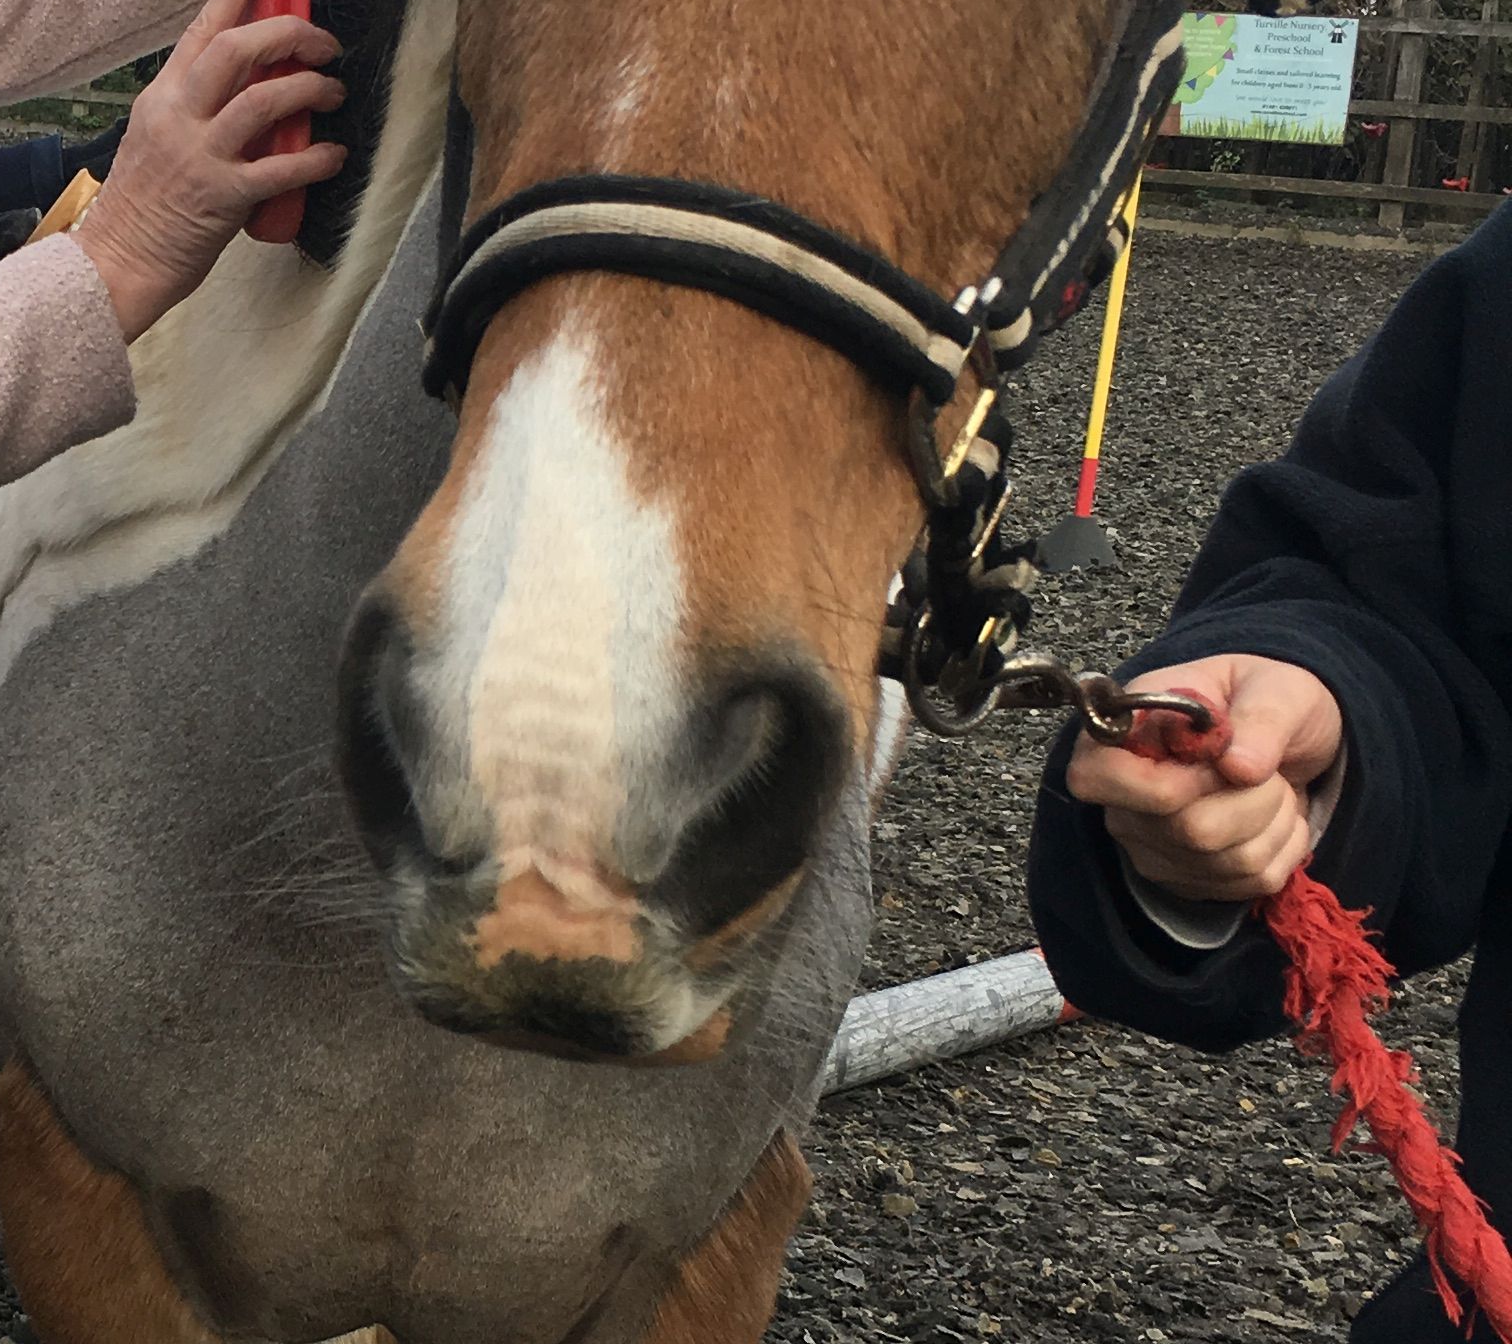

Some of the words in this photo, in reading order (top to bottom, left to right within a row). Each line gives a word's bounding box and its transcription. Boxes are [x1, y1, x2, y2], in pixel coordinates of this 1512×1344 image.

[1255, 19, 1288, 29] Turville
[1267, 32, 1311, 42] Preschool
[1254, 45, 1261, 53] &
[1263, 45, 1291, 54] Forest
[1293, 45, 1324, 56] School
[1289, 70, 1314, 78] tailored
[1314, 71, 1341, 81] learning
[1267, 82, 1282, 90] aged
